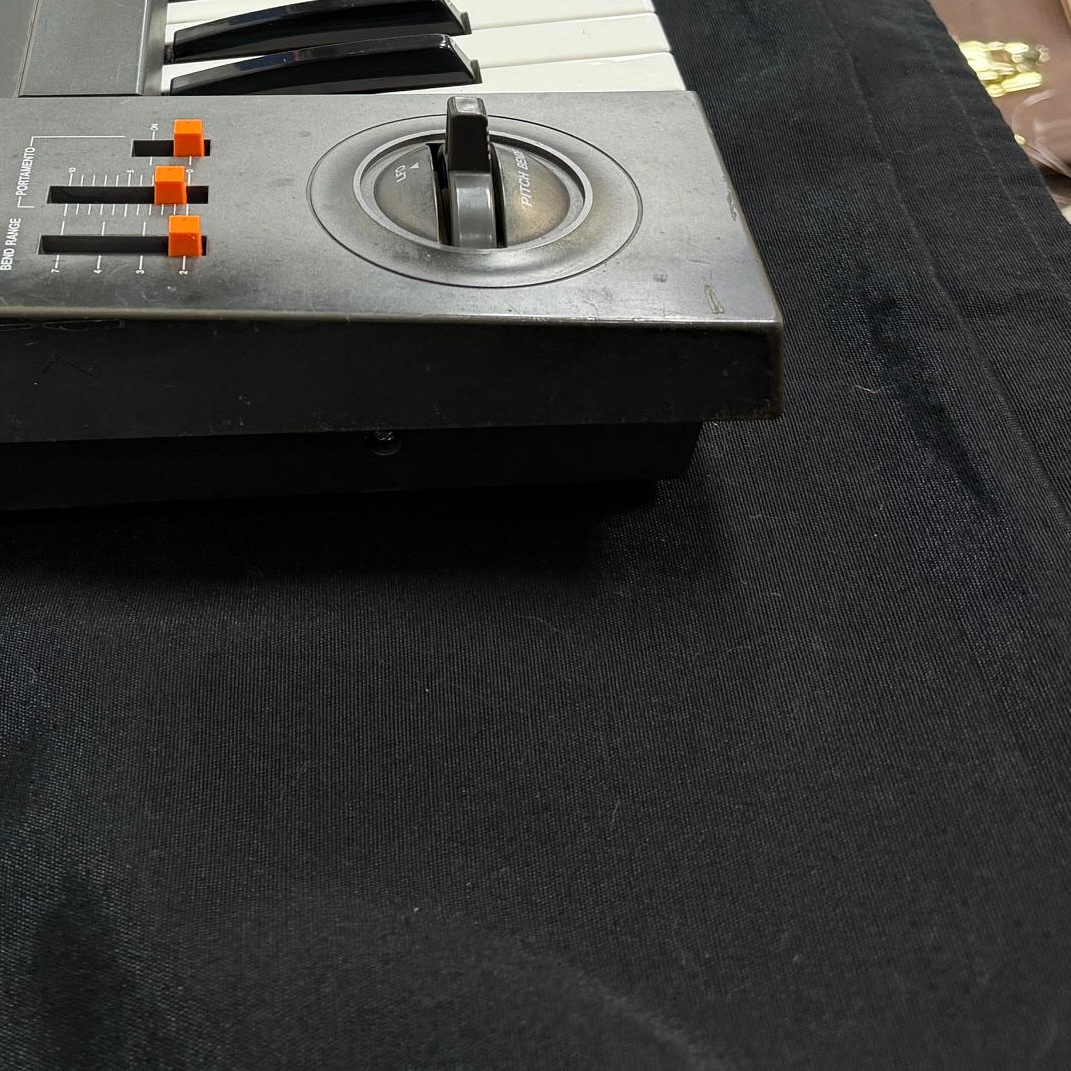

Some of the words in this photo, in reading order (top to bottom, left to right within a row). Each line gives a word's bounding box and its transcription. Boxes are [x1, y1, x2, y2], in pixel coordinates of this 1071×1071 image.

[15, 146, 36, 196] PORTAMENTO
[396, 164, 406, 183] LFO
[518, 170, 532, 207] PITCH
[5, 217, 22, 246] RANGE
[0, 247, 17, 271] BEND
